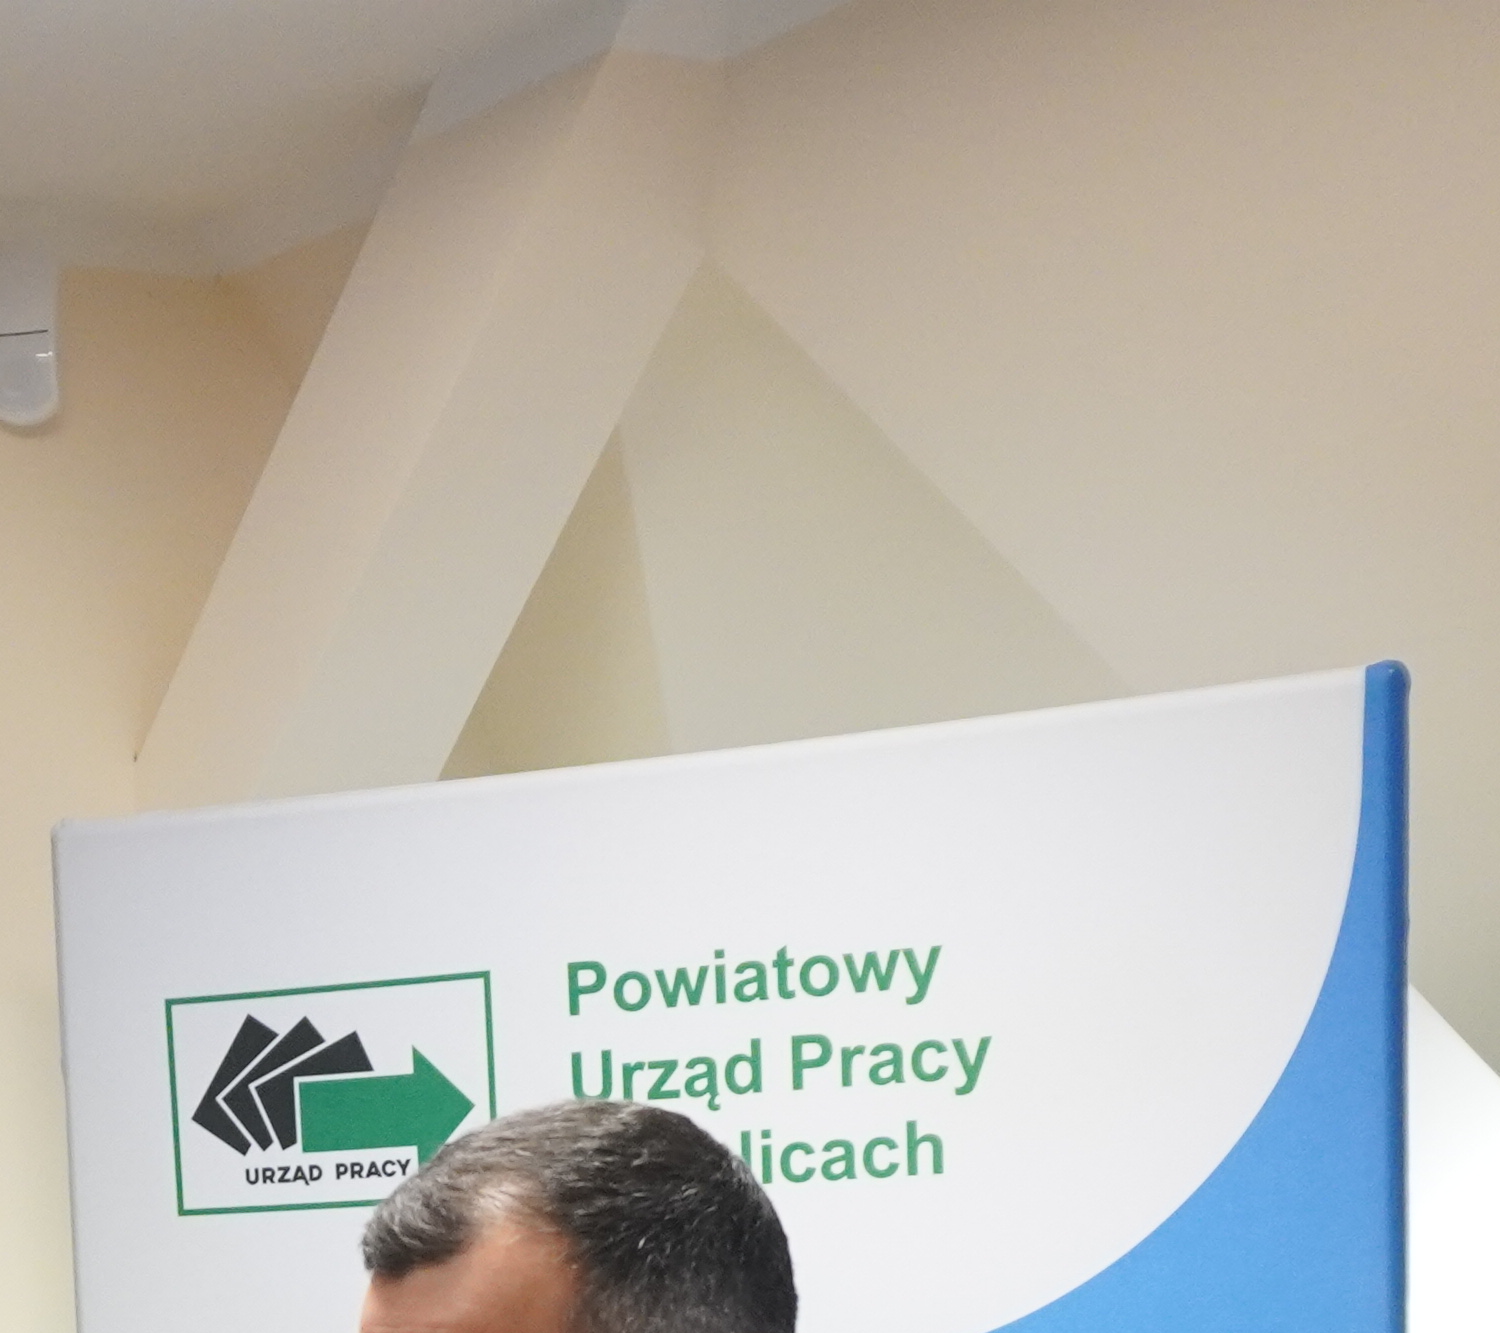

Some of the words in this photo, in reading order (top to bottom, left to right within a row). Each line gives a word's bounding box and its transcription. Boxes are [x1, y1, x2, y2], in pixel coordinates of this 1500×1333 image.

[567, 945, 942, 1016] Powiatowy
[571, 1038, 762, 1111] Urząd
[791, 1033, 992, 1096] Pracy
[245, 1164, 323, 1186] URZĄD
[335, 1159, 411, 1180] PRACY
[740, 1120, 944, 1184] licach
